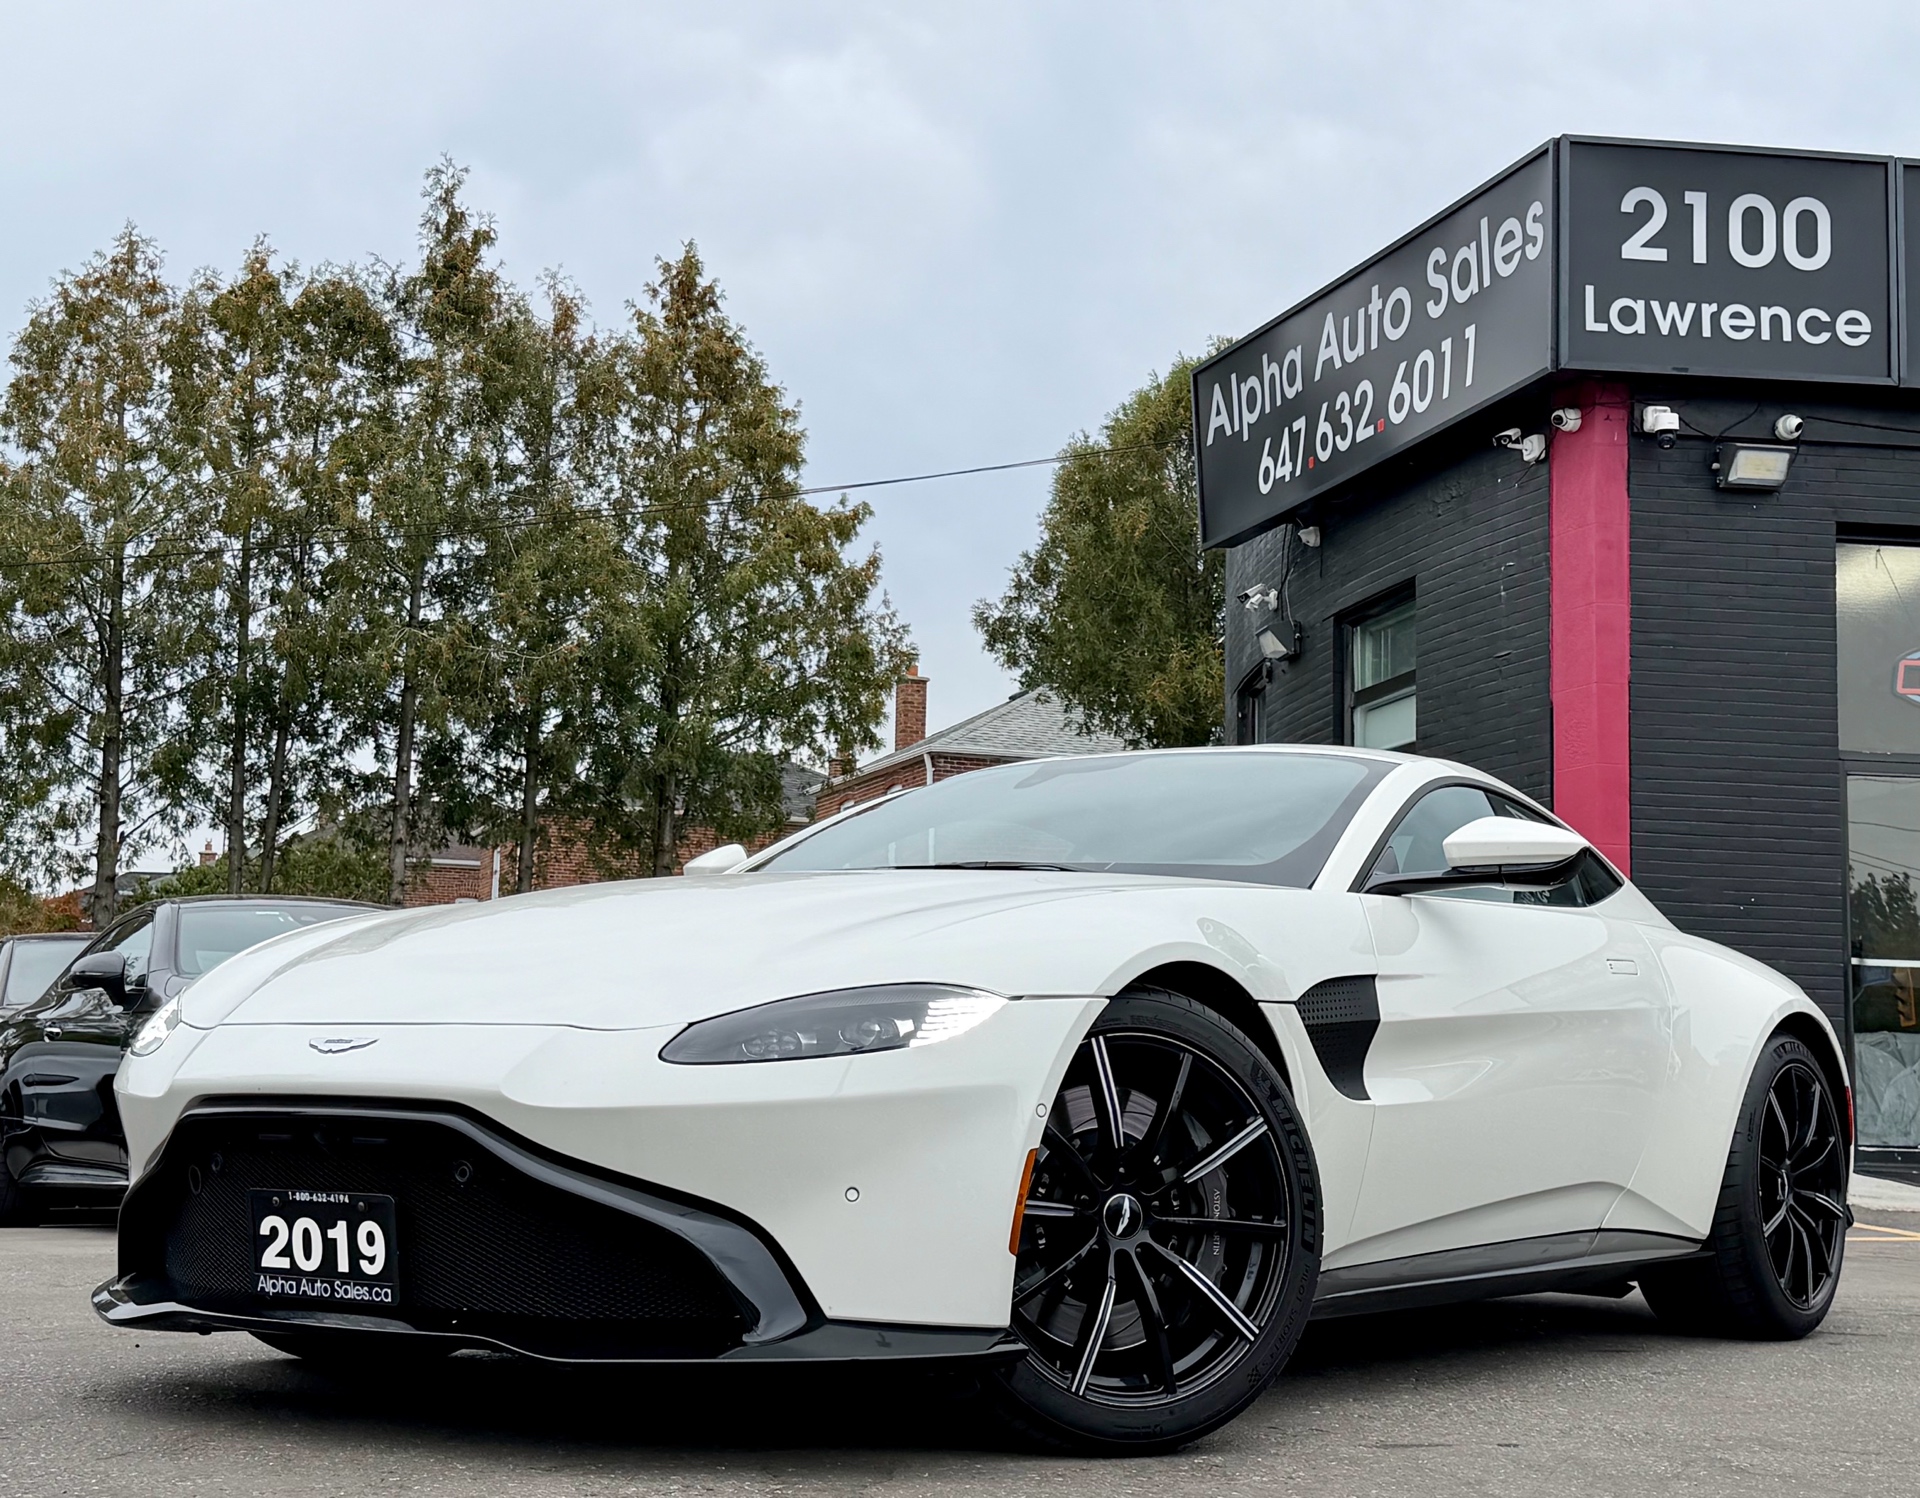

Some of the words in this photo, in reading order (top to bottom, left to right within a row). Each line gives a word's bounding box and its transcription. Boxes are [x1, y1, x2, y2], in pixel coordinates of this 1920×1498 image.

[1620, 186, 1832, 271] 2100
[1206, 344, 1304, 447] Alpha
[1313, 284, 1412, 382] Auto
[1426, 200, 1545, 319] Sales
[1584, 284, 1872, 347] Lawrence
[1258, 324, 1477, 495] 647.632.6011
[287, 1190, 350, 1204] 1-800-632-4194
[1271, 1097, 1314, 1244] MICHELIN
[259, 1215, 386, 1276] 2019
[257, 1275, 297, 1296] Alpha
[299, 1278, 331, 1297] Auto
[334, 1280, 392, 1302] Sales.ca
